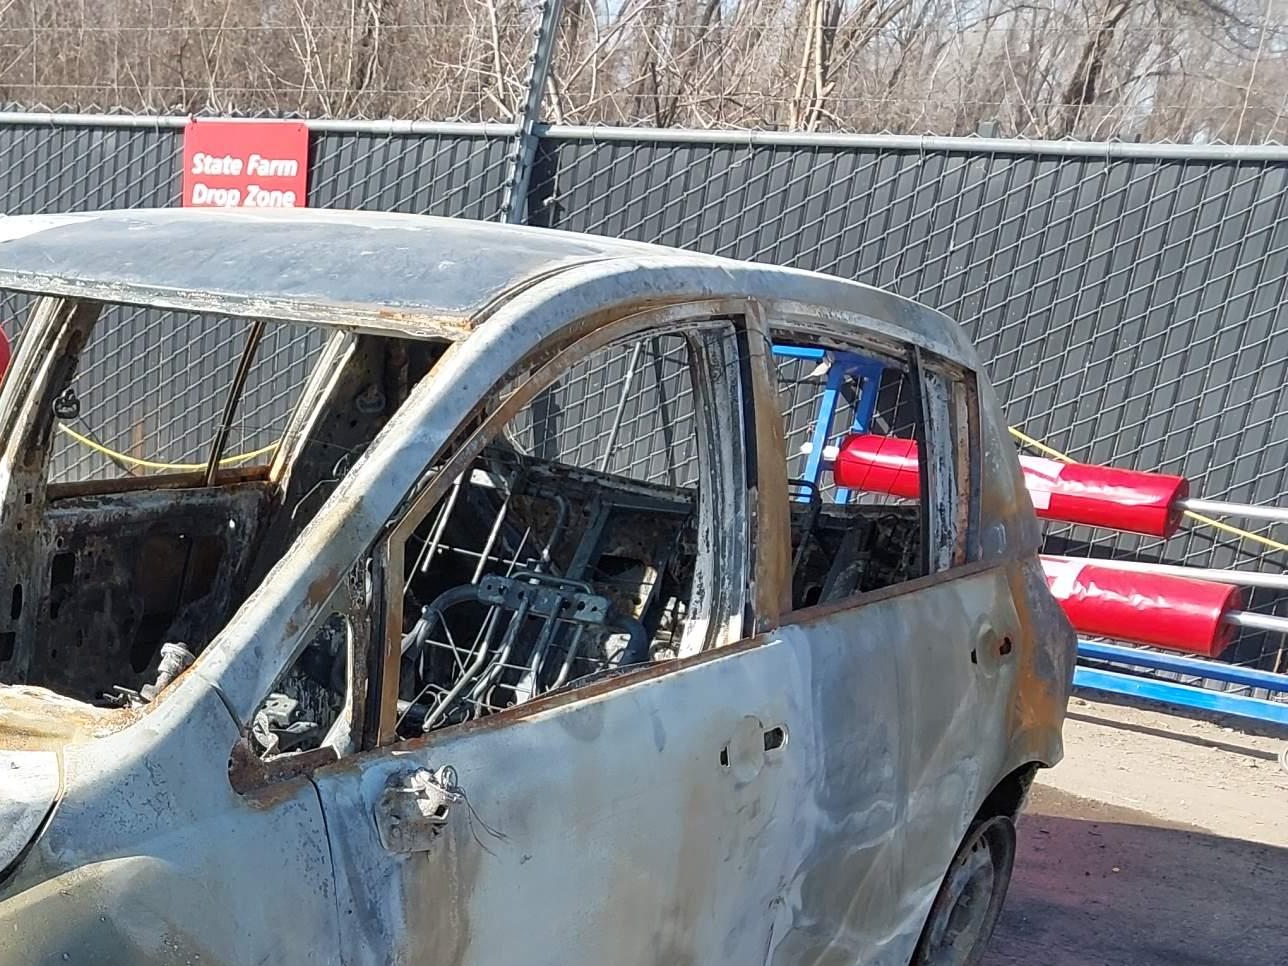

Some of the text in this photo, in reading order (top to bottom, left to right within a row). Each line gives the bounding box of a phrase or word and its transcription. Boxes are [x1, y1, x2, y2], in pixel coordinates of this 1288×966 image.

[192, 152, 298, 176] State Farm
[192, 183, 296, 207] Drop Zone
